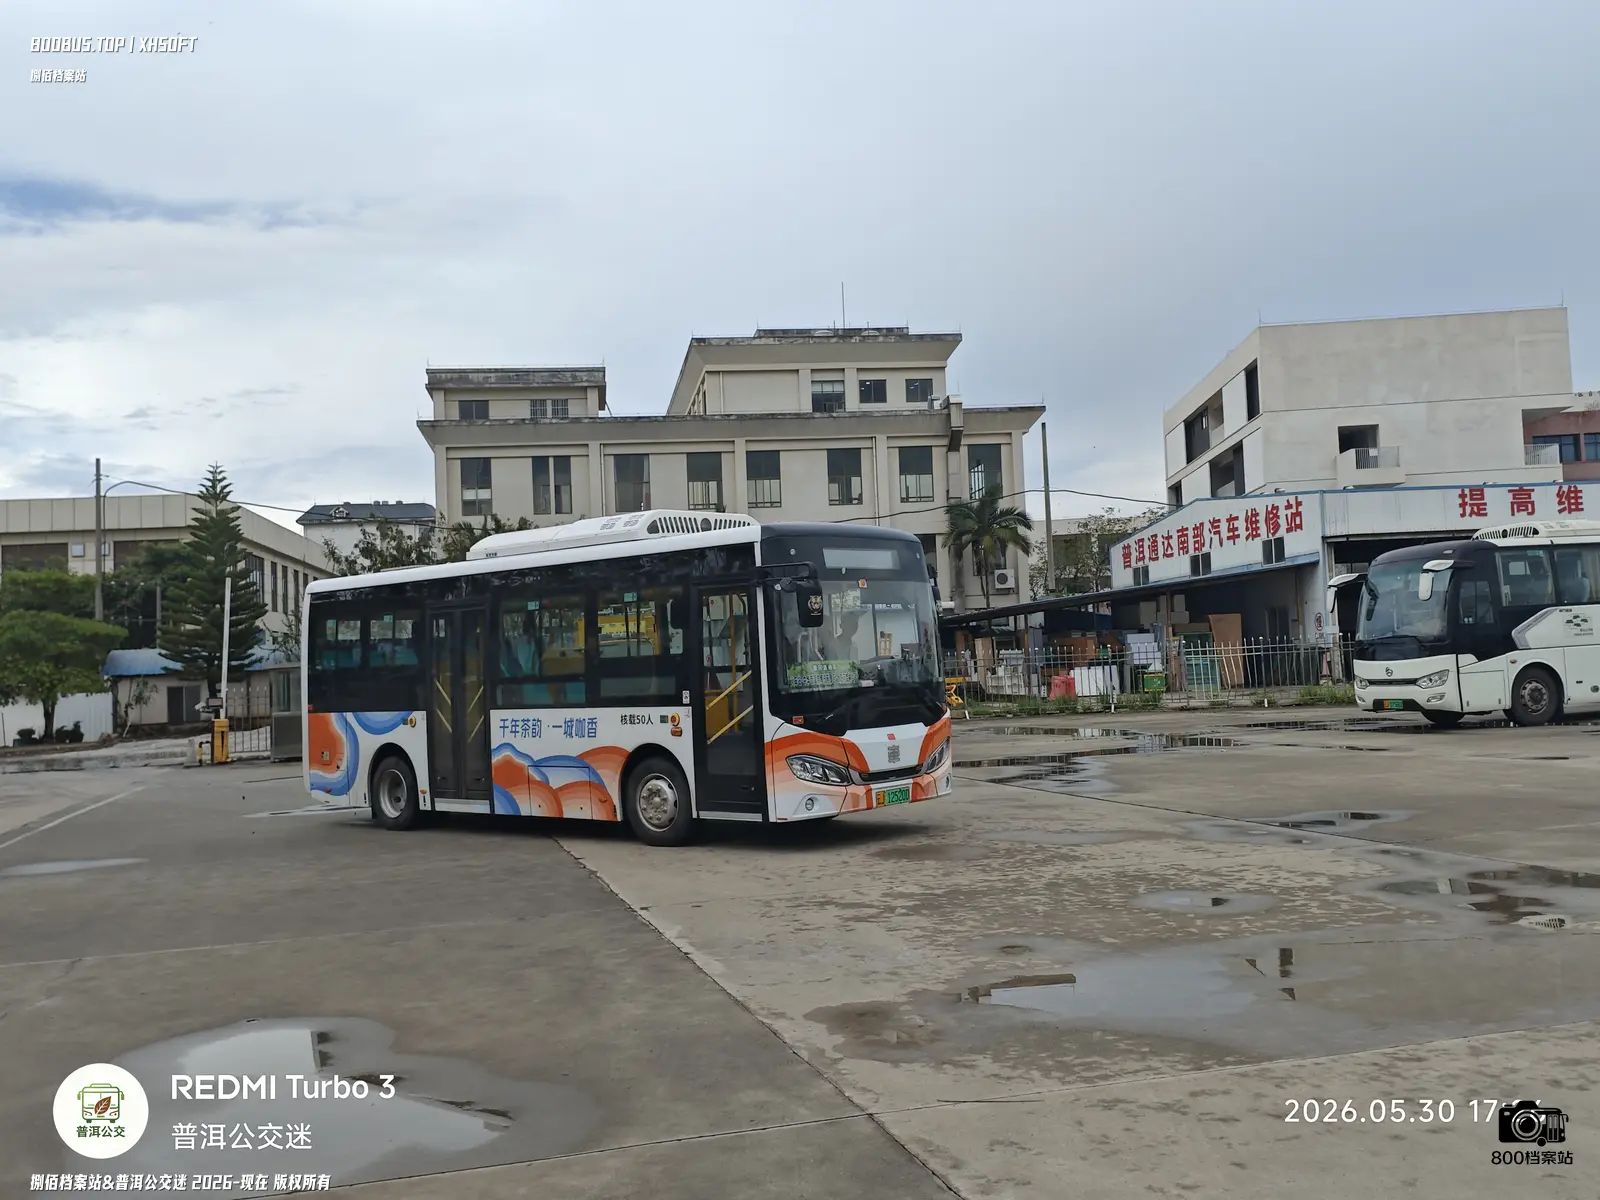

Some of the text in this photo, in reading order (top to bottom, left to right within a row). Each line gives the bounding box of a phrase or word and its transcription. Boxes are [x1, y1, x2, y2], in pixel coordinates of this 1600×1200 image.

[1458, 485, 1584, 518] 提高维
[1121, 496, 1303, 569] 普洱通达南部汽车维修站
[620, 714, 654, 726] 核载50人
